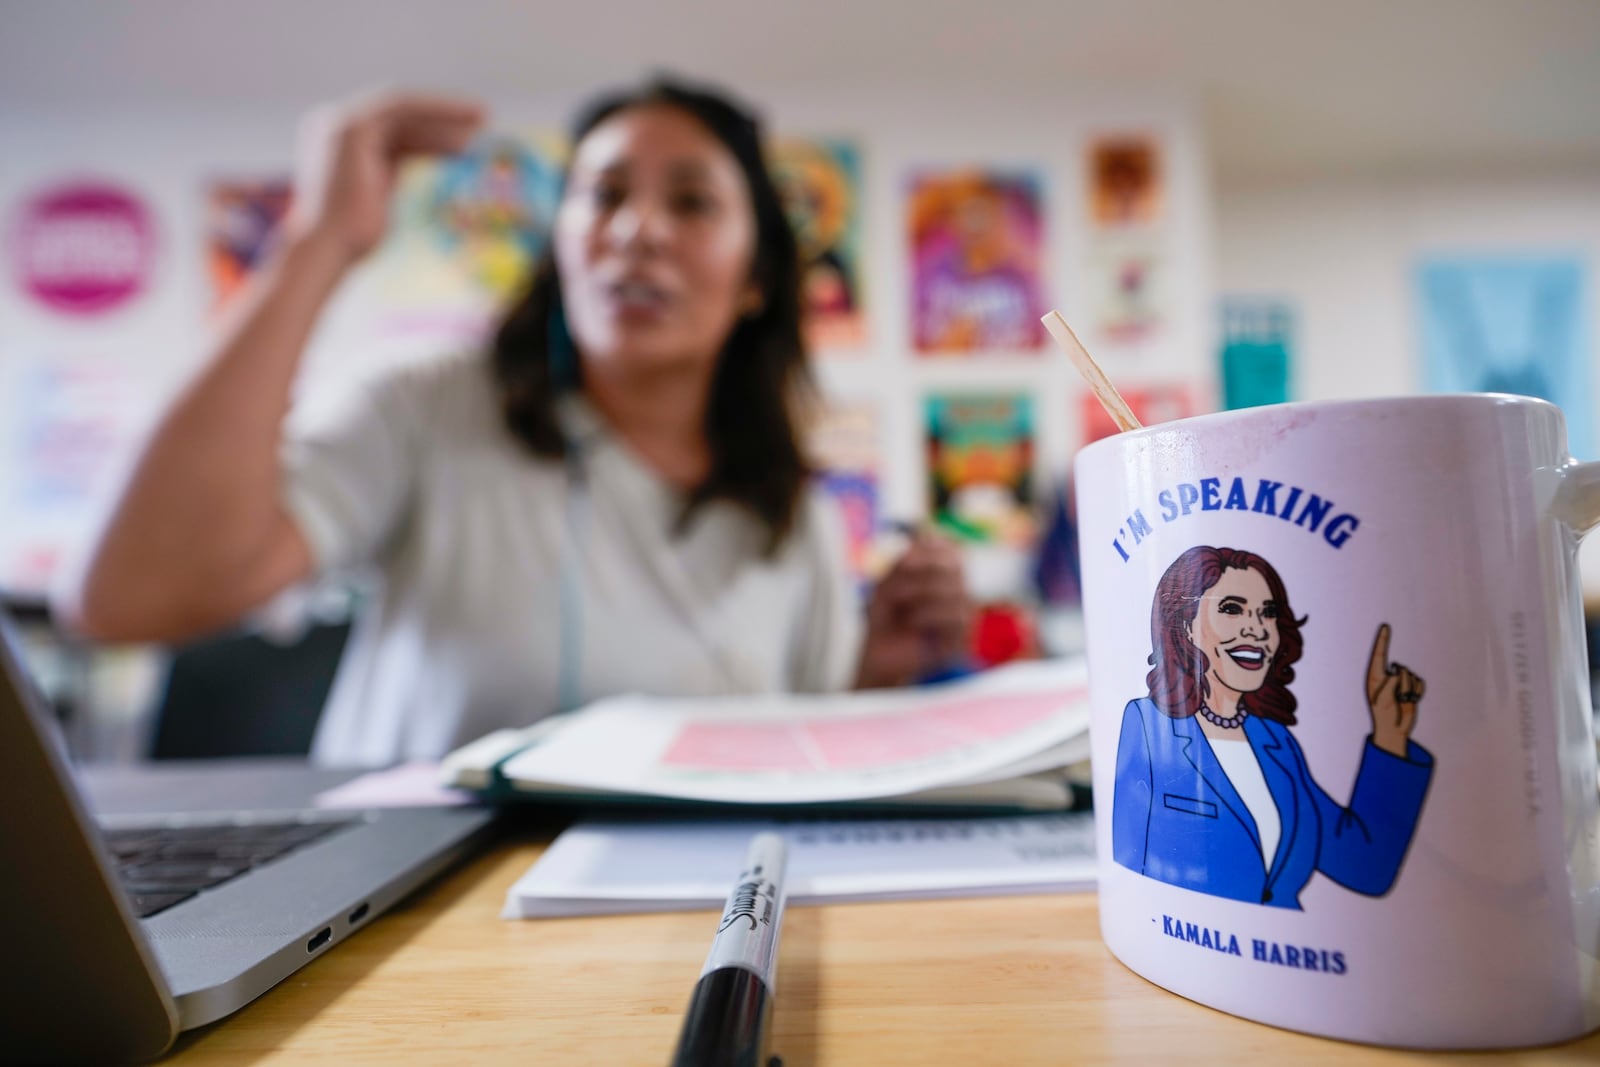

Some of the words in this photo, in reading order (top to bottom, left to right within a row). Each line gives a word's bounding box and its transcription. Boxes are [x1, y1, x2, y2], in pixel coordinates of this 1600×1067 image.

[1112, 508, 1153, 563] I'M
[1157, 476, 1361, 550] SPEAKING
[1162, 914, 1242, 957] KAMALA
[1252, 938, 1348, 976] HARRIS
